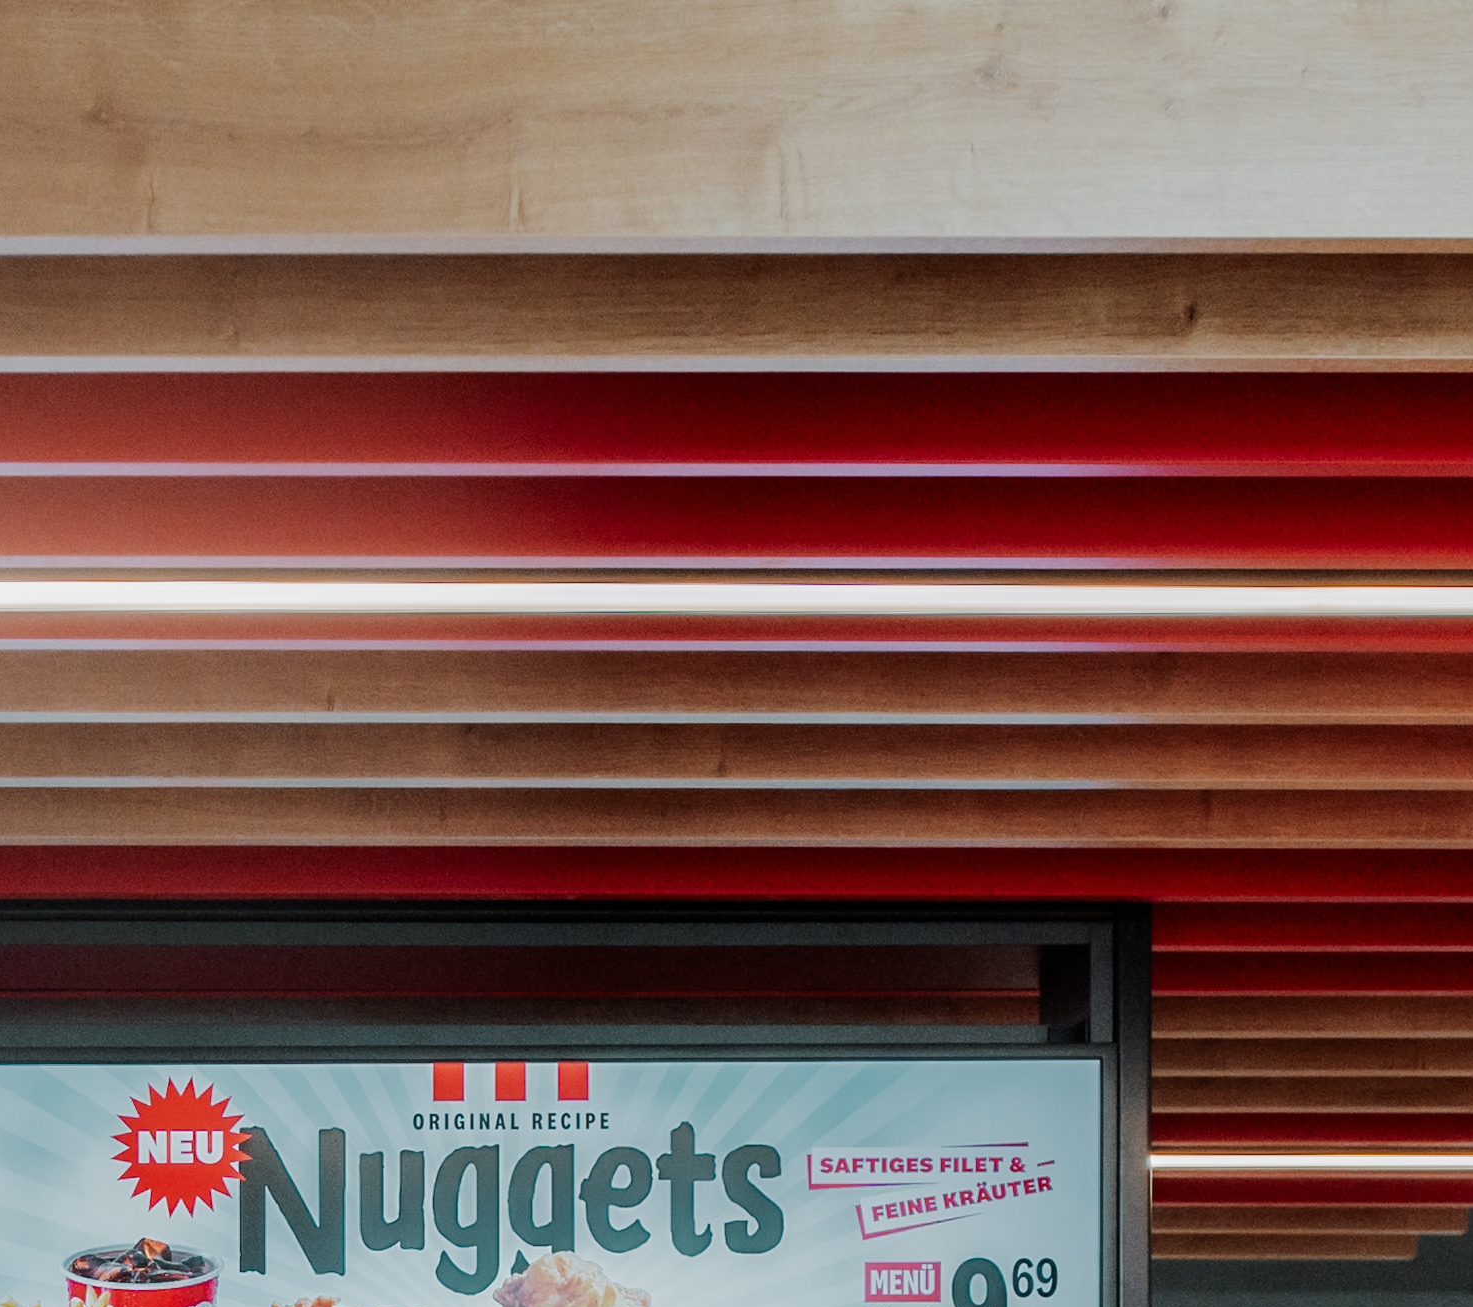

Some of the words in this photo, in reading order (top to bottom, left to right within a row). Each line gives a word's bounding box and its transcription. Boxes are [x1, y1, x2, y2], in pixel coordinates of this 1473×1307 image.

[412, 1112, 520, 1131] ORIGINAL
[532, 1112, 610, 1130] RECIPE
[138, 1131, 224, 1164] NEU
[820, 1157, 933, 1174] SAFTIGES
[940, 1157, 1005, 1174] FILET
[239, 1121, 784, 1294] Nuggets
[871, 1196, 938, 1223] FEINE
[943, 1178, 1053, 1209] KRÄUTER
[870, 1265, 935, 1296] MENÜ
